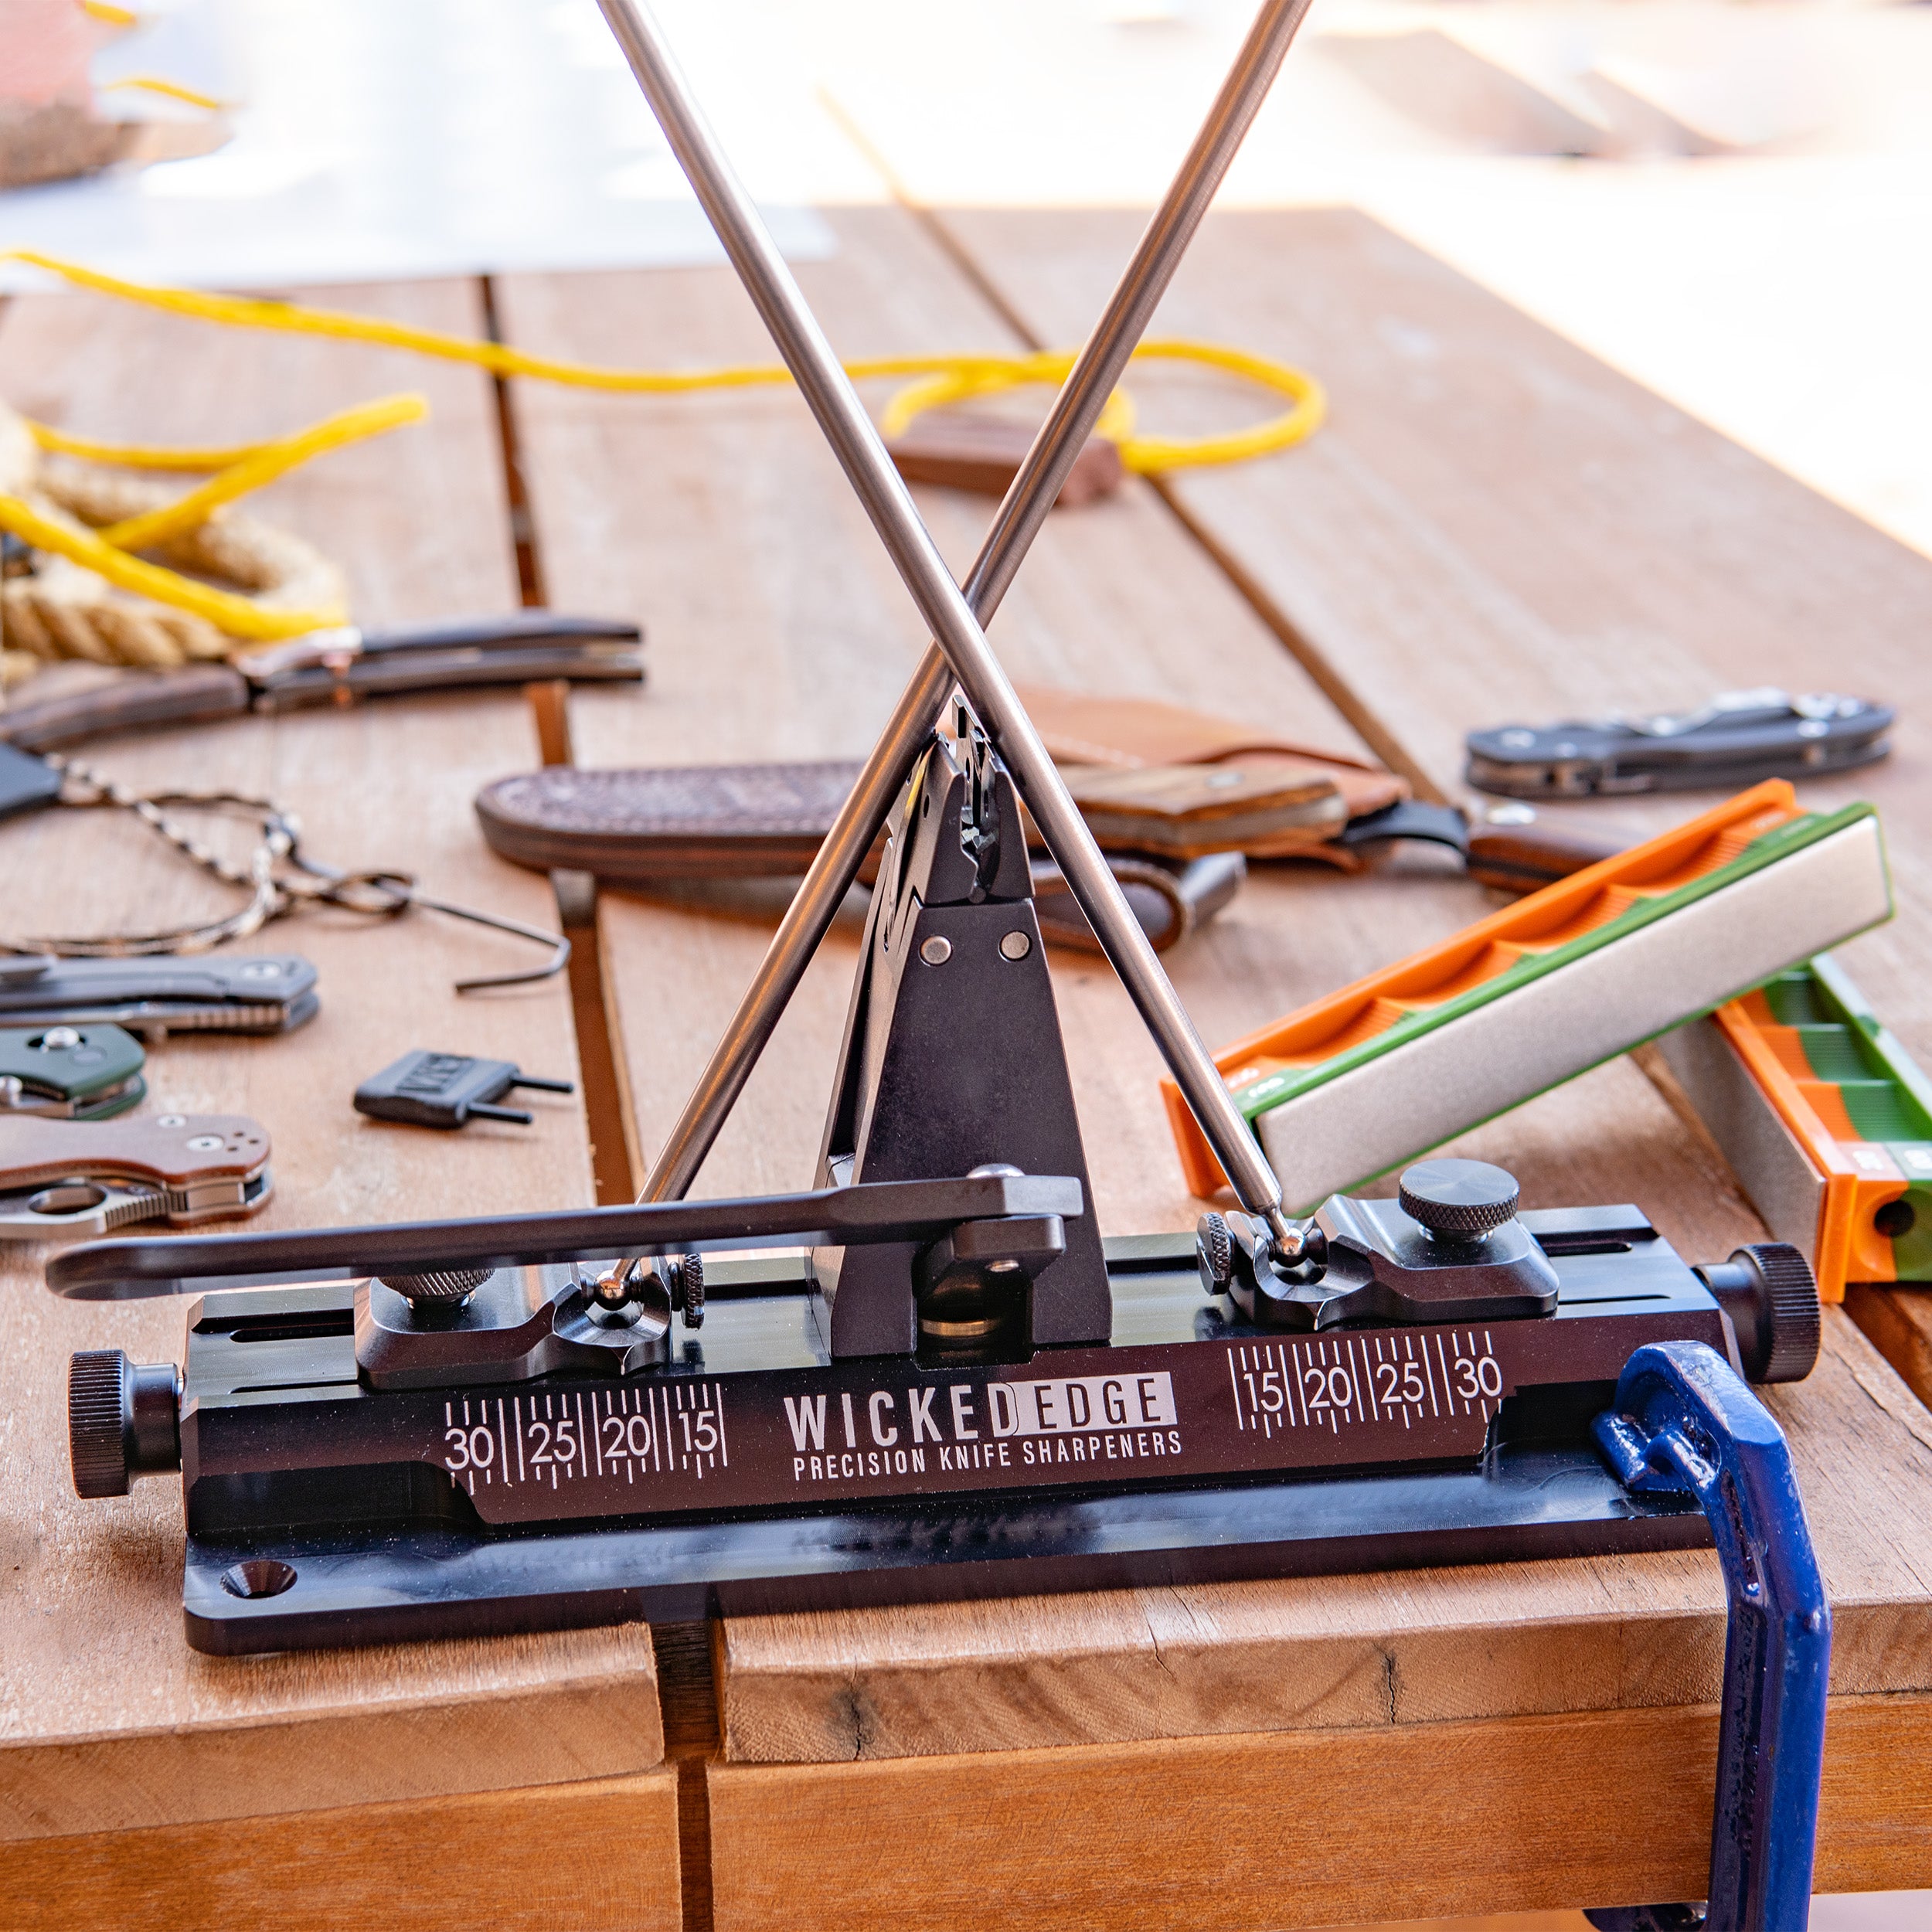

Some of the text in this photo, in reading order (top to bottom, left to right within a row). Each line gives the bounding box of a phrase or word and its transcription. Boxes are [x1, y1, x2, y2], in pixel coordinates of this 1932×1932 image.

[1243, 1356, 1502, 1412] 15 20 25 30
[445, 1410, 718, 1469] 30 25 20 15
[784, 1377, 1163, 1451] WICKED EDGE
[793, 1431, 1182, 1481] PRECISION KNIFE SHARPENERS
